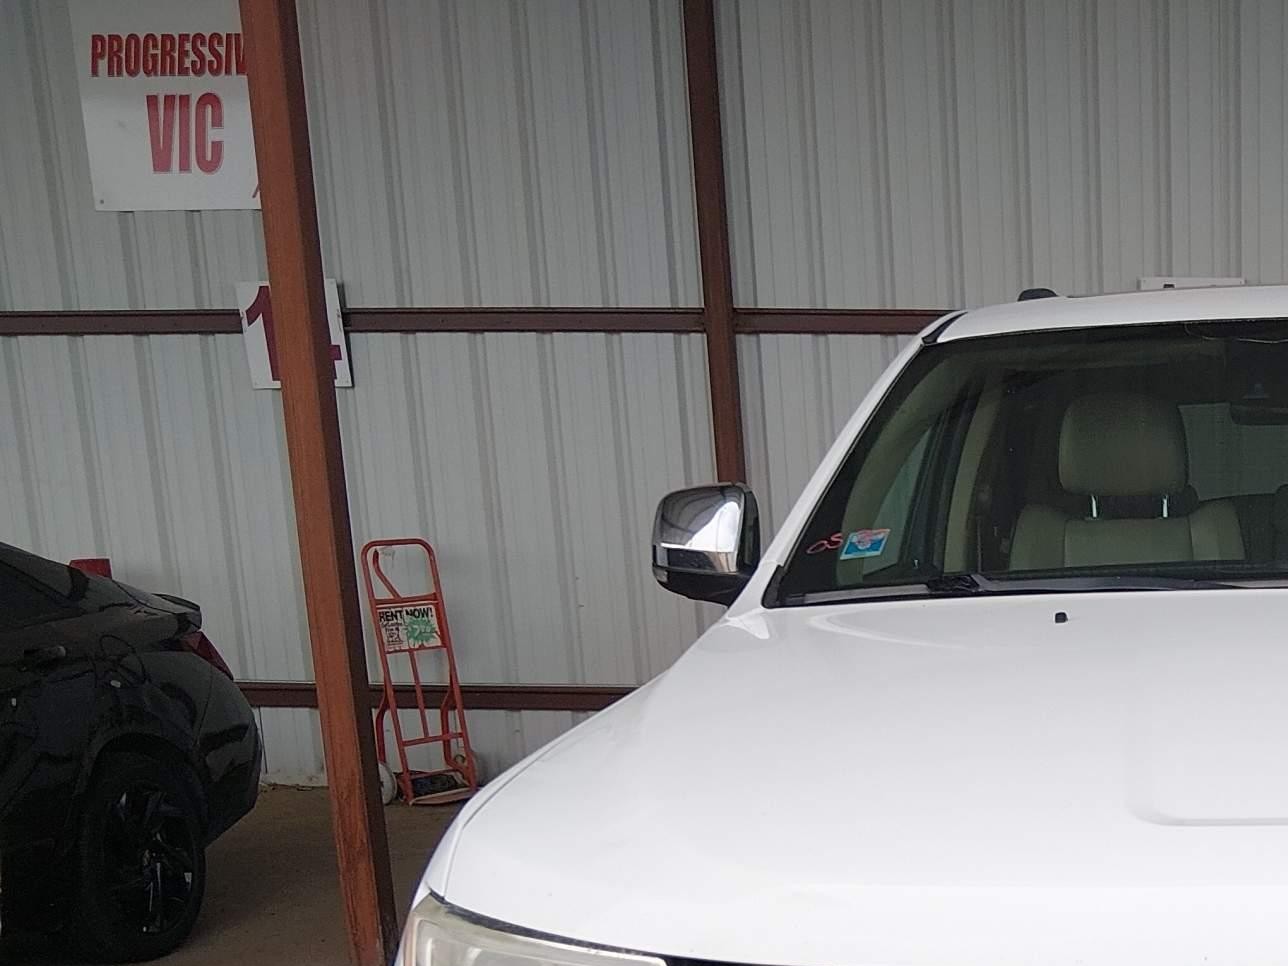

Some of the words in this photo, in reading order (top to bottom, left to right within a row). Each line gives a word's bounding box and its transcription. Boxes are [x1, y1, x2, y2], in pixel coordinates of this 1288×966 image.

[145, 92, 225, 175] VIC
[378, 609, 404, 622] RENT
[404, 607, 434, 619] NOW!
